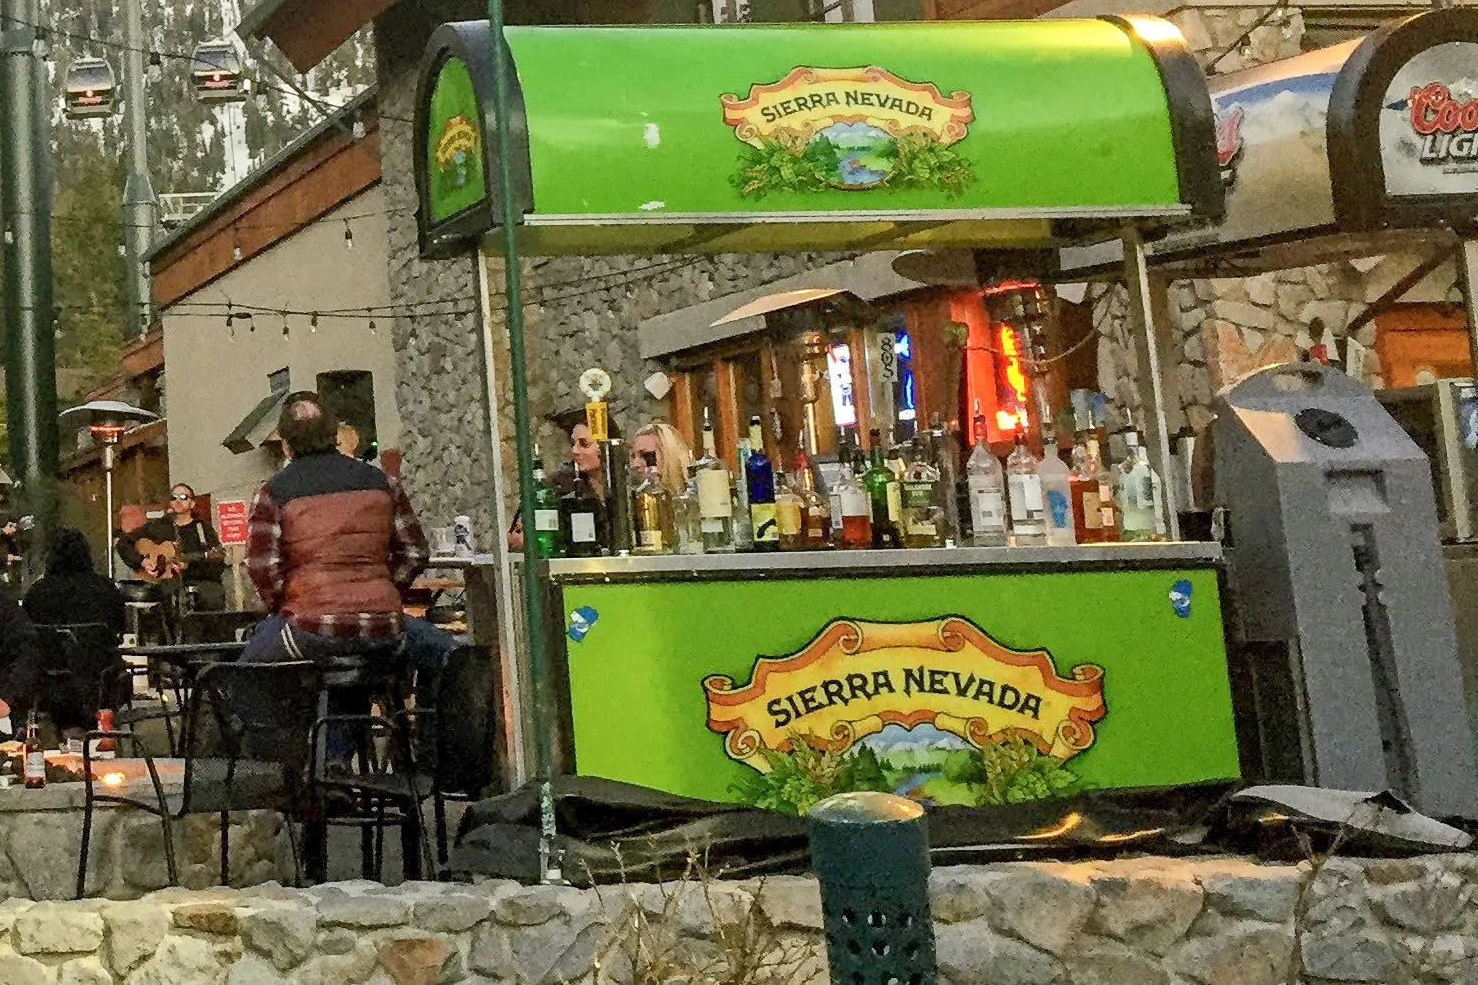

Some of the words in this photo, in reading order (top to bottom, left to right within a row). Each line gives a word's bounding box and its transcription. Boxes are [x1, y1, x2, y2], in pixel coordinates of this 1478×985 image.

[761, 91, 841, 123] SIERRA
[844, 90, 934, 121] NEVADA
[766, 670, 896, 729] SIERRA
[902, 665, 1043, 720] NEVADA
